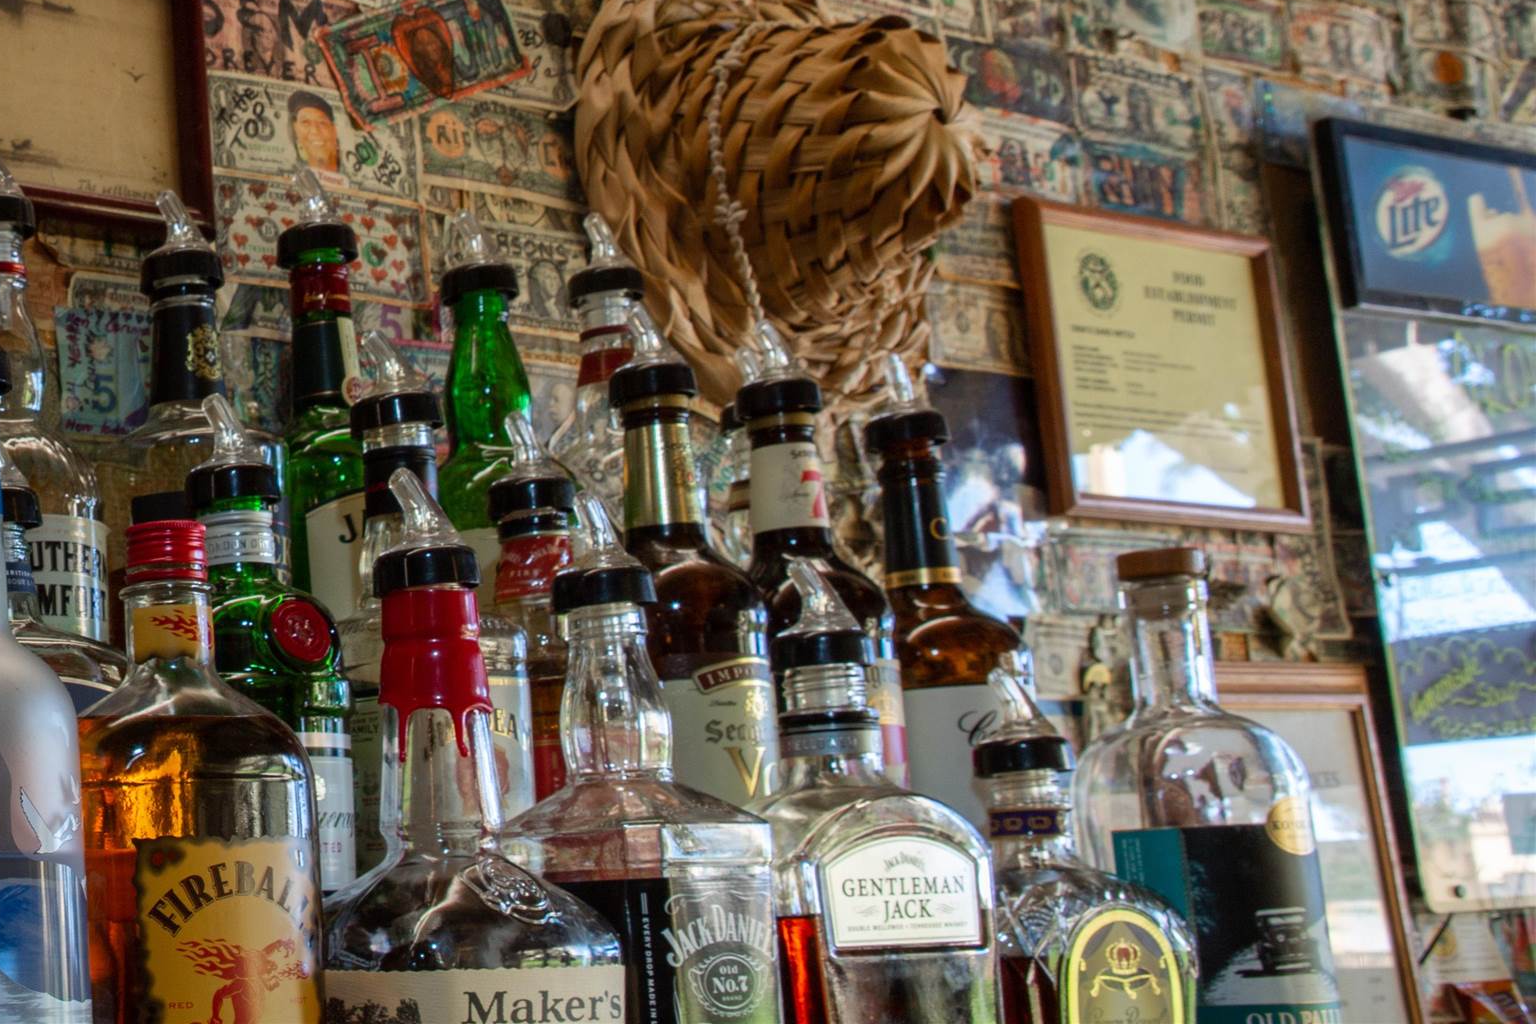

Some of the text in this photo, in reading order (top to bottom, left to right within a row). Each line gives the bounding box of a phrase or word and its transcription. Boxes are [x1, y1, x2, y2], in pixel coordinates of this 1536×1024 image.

[205, 47, 320, 85] OREVER
[38, 583, 107, 623] MFORT
[703, 664, 756, 690] IMPO
[147, 860, 310, 939] FIREBAL
[841, 875, 965, 898] GENTLEMAN
[882, 898, 935, 923] JACK
[661, 913, 715, 968] JACK
[718, 964, 739, 976] Old
[711, 975, 749, 995] No.7
[168, 1001, 195, 1010] RED
[462, 986, 623, 1024] Maker's
